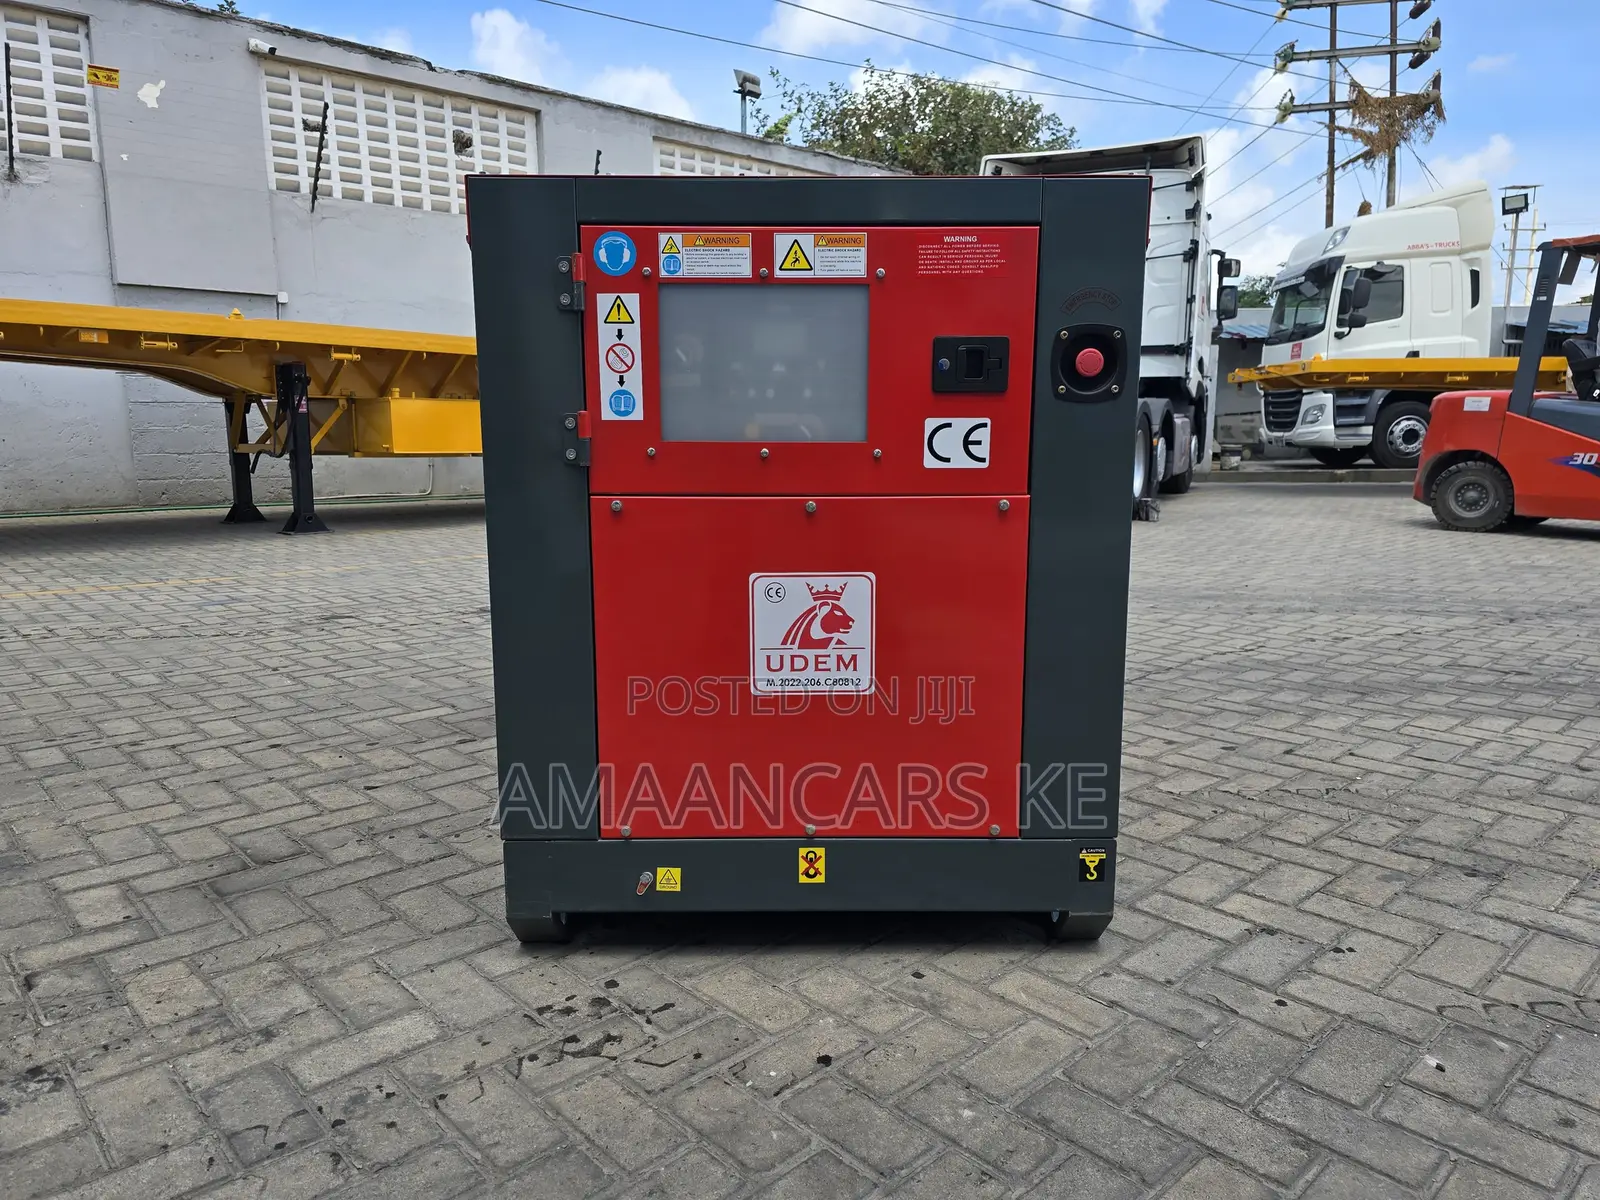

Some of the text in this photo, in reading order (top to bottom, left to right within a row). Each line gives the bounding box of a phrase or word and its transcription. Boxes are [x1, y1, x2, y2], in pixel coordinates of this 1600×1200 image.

[1102, 292, 1118, 306] STOP
[927, 422, 988, 463] CE
[1568, 452, 1598, 465] 30
[767, 587, 782, 598] CE
[766, 654, 858, 672] UDEM
